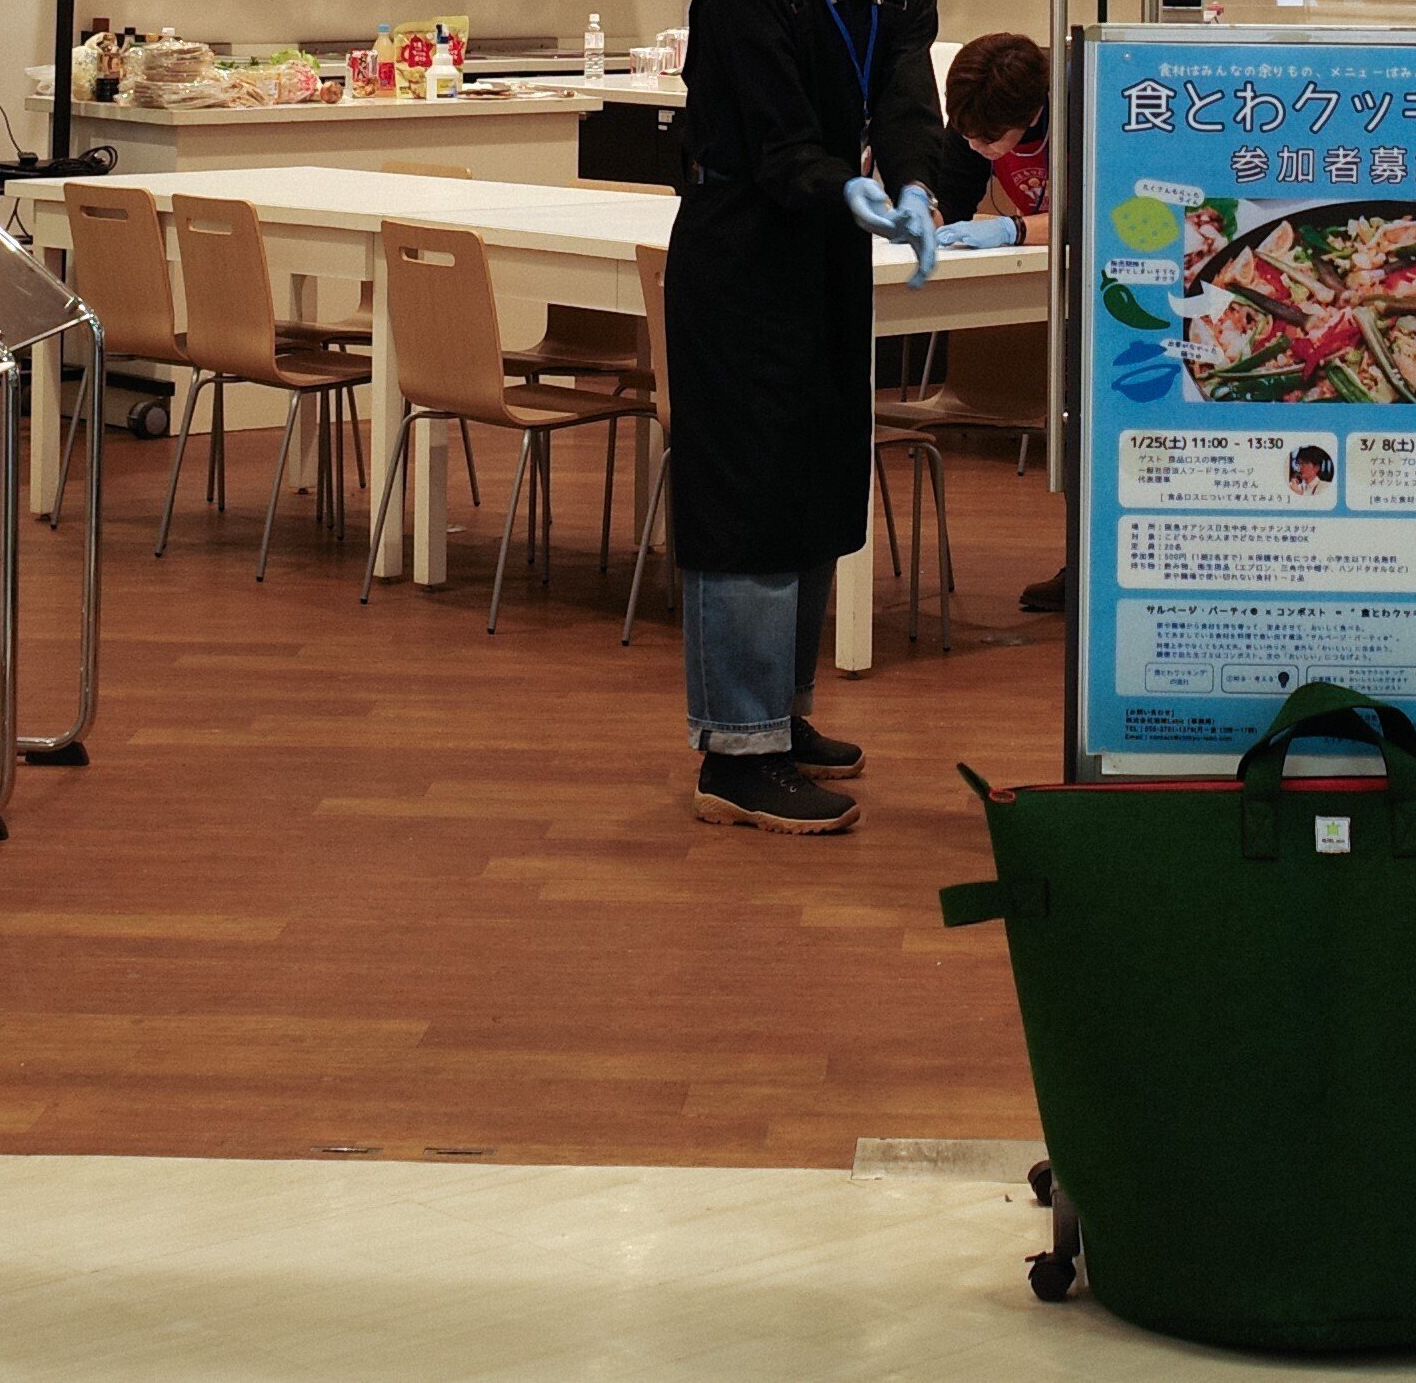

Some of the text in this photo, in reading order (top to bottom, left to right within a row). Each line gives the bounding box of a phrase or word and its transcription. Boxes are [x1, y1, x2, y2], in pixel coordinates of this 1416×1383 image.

[1130, 436, 1187, 450] 1/25(土)
[1191, 437, 1228, 449] 11:00
[1247, 437, 1284, 449] 13:30
